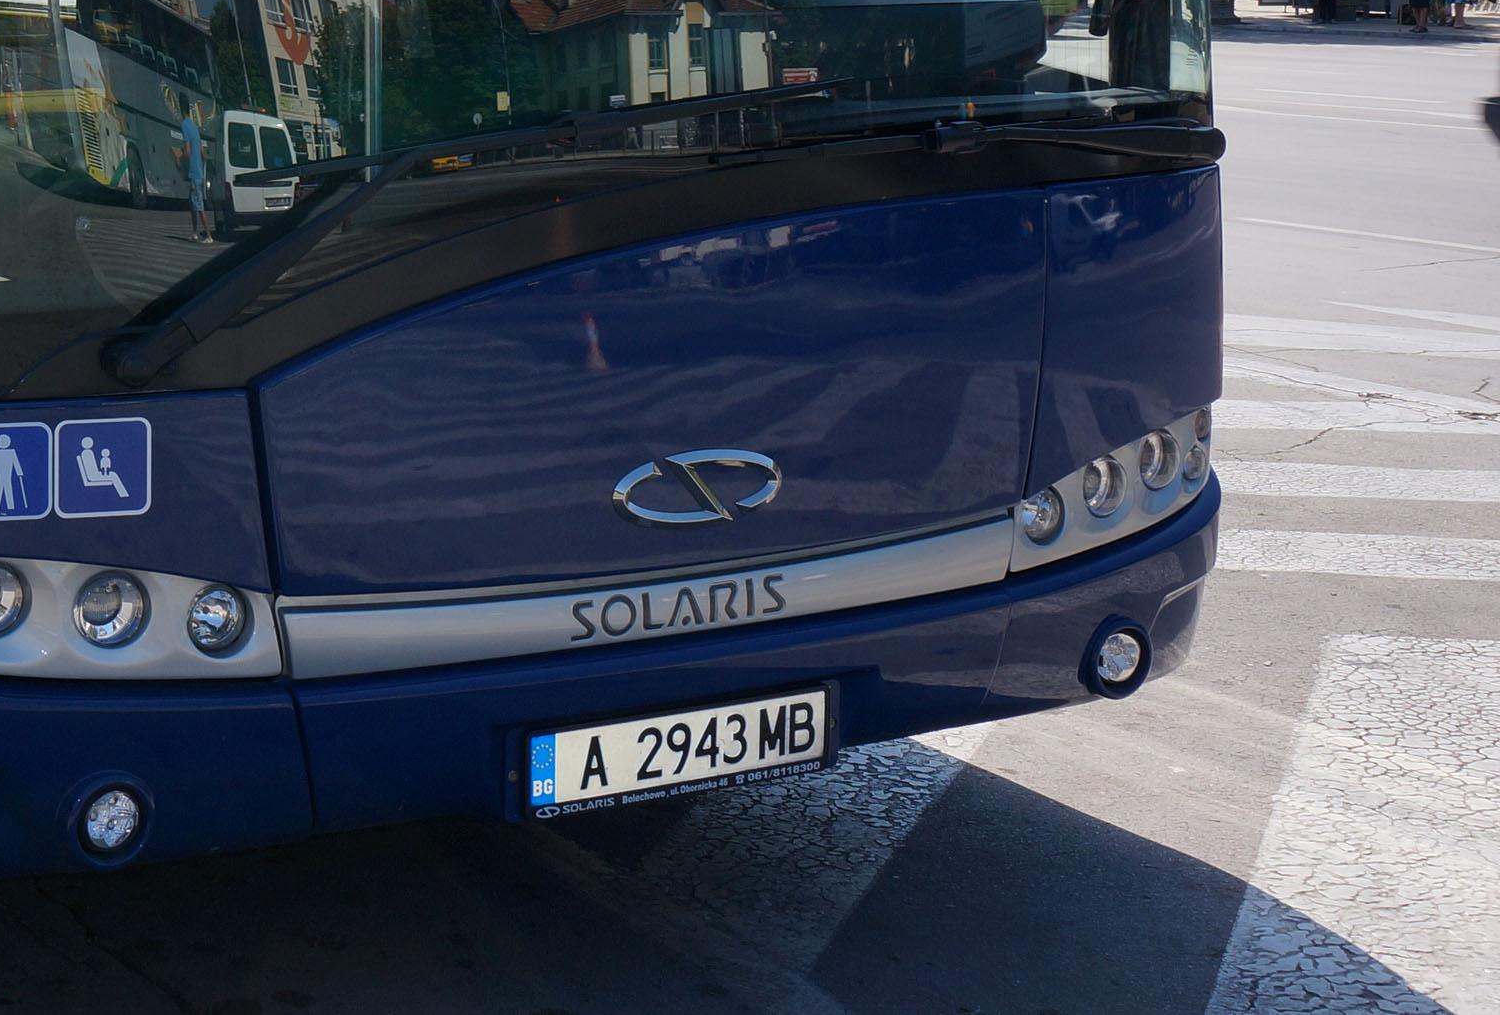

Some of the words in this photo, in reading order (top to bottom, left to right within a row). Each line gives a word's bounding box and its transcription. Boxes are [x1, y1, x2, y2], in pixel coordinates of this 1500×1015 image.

[570, 573, 787, 642] SOLARIS
[580, 736, 609, 790] A
[636, 714, 748, 781] 2943
[759, 702, 814, 760] MB
[532, 778, 553, 797] BG
[562, 797, 615, 815] SOLARIS
[747, 761, 820, 782] 061/8118300
